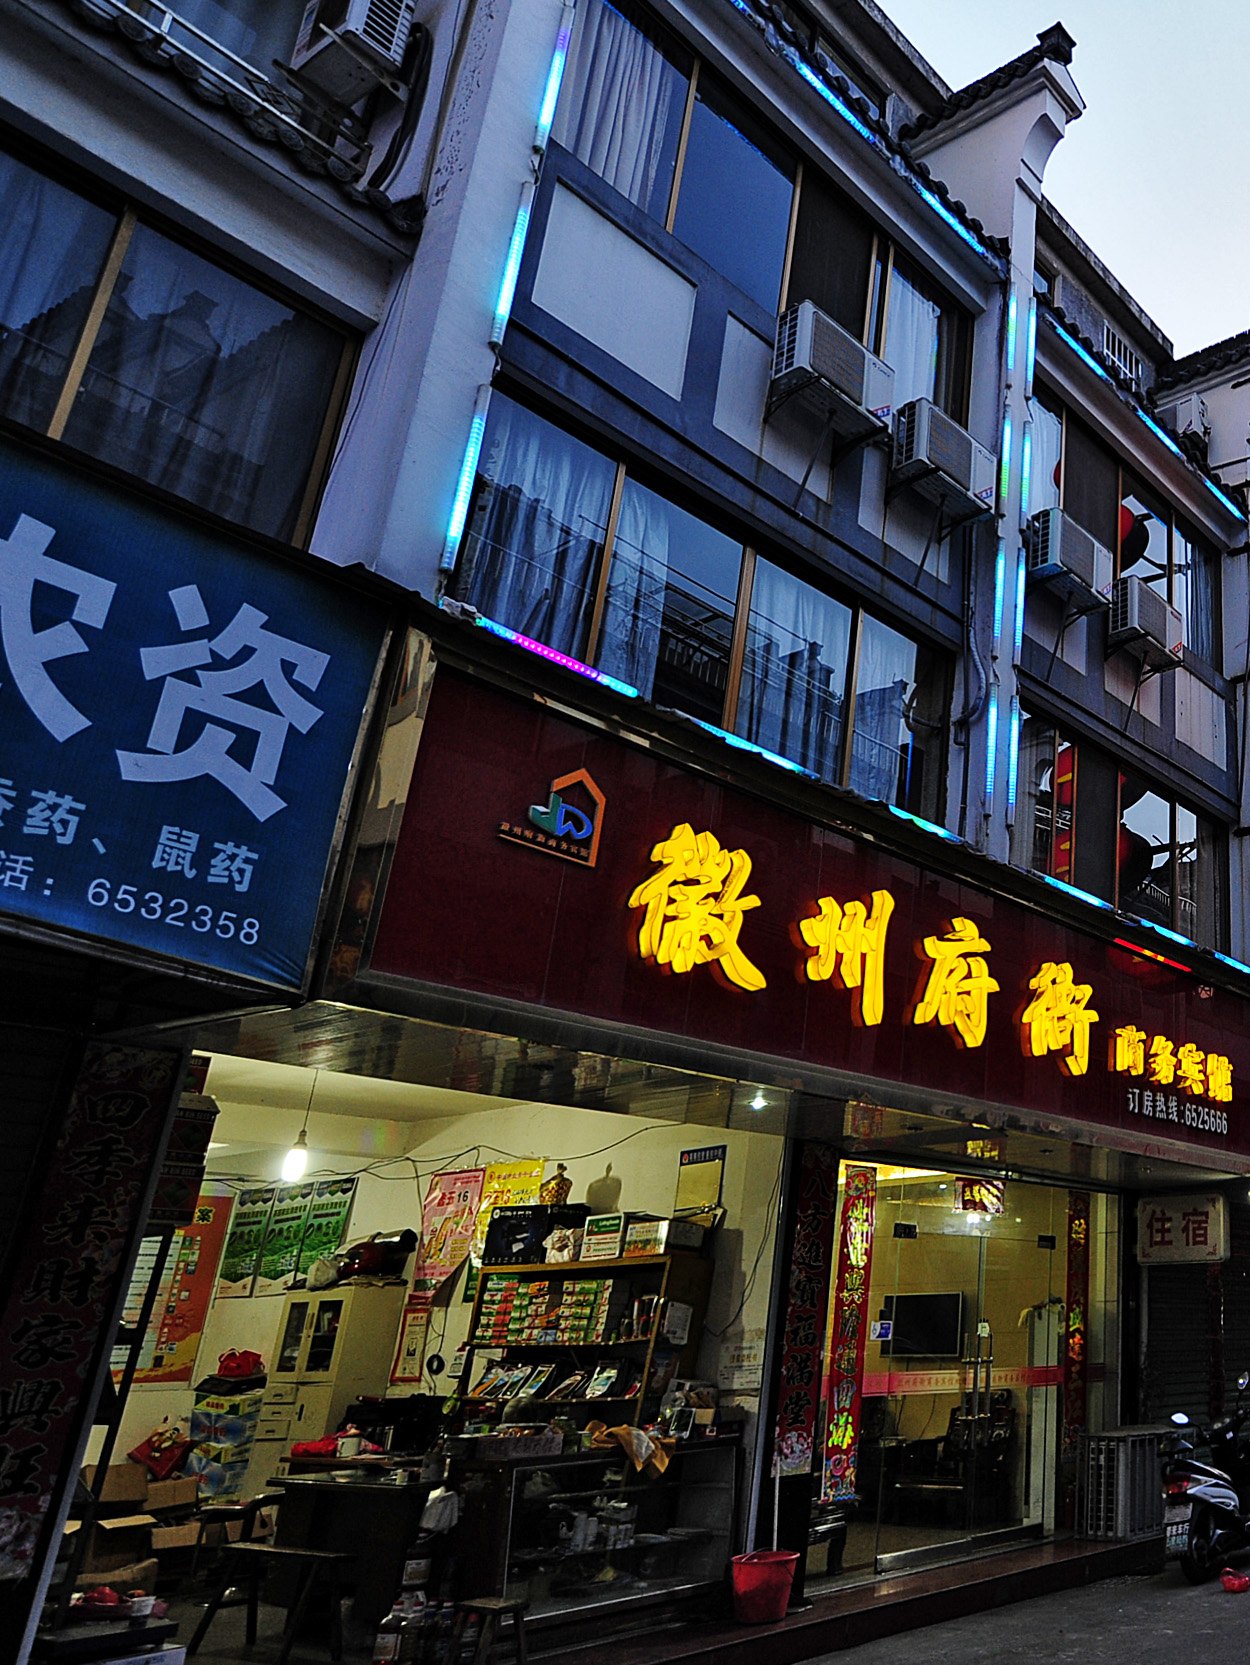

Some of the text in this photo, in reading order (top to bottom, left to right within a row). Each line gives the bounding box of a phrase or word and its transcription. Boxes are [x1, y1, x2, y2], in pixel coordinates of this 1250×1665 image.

[1114, 1024, 1234, 1102] 商务宾馆
[1146, 1207, 1210, 1248] 住宿
